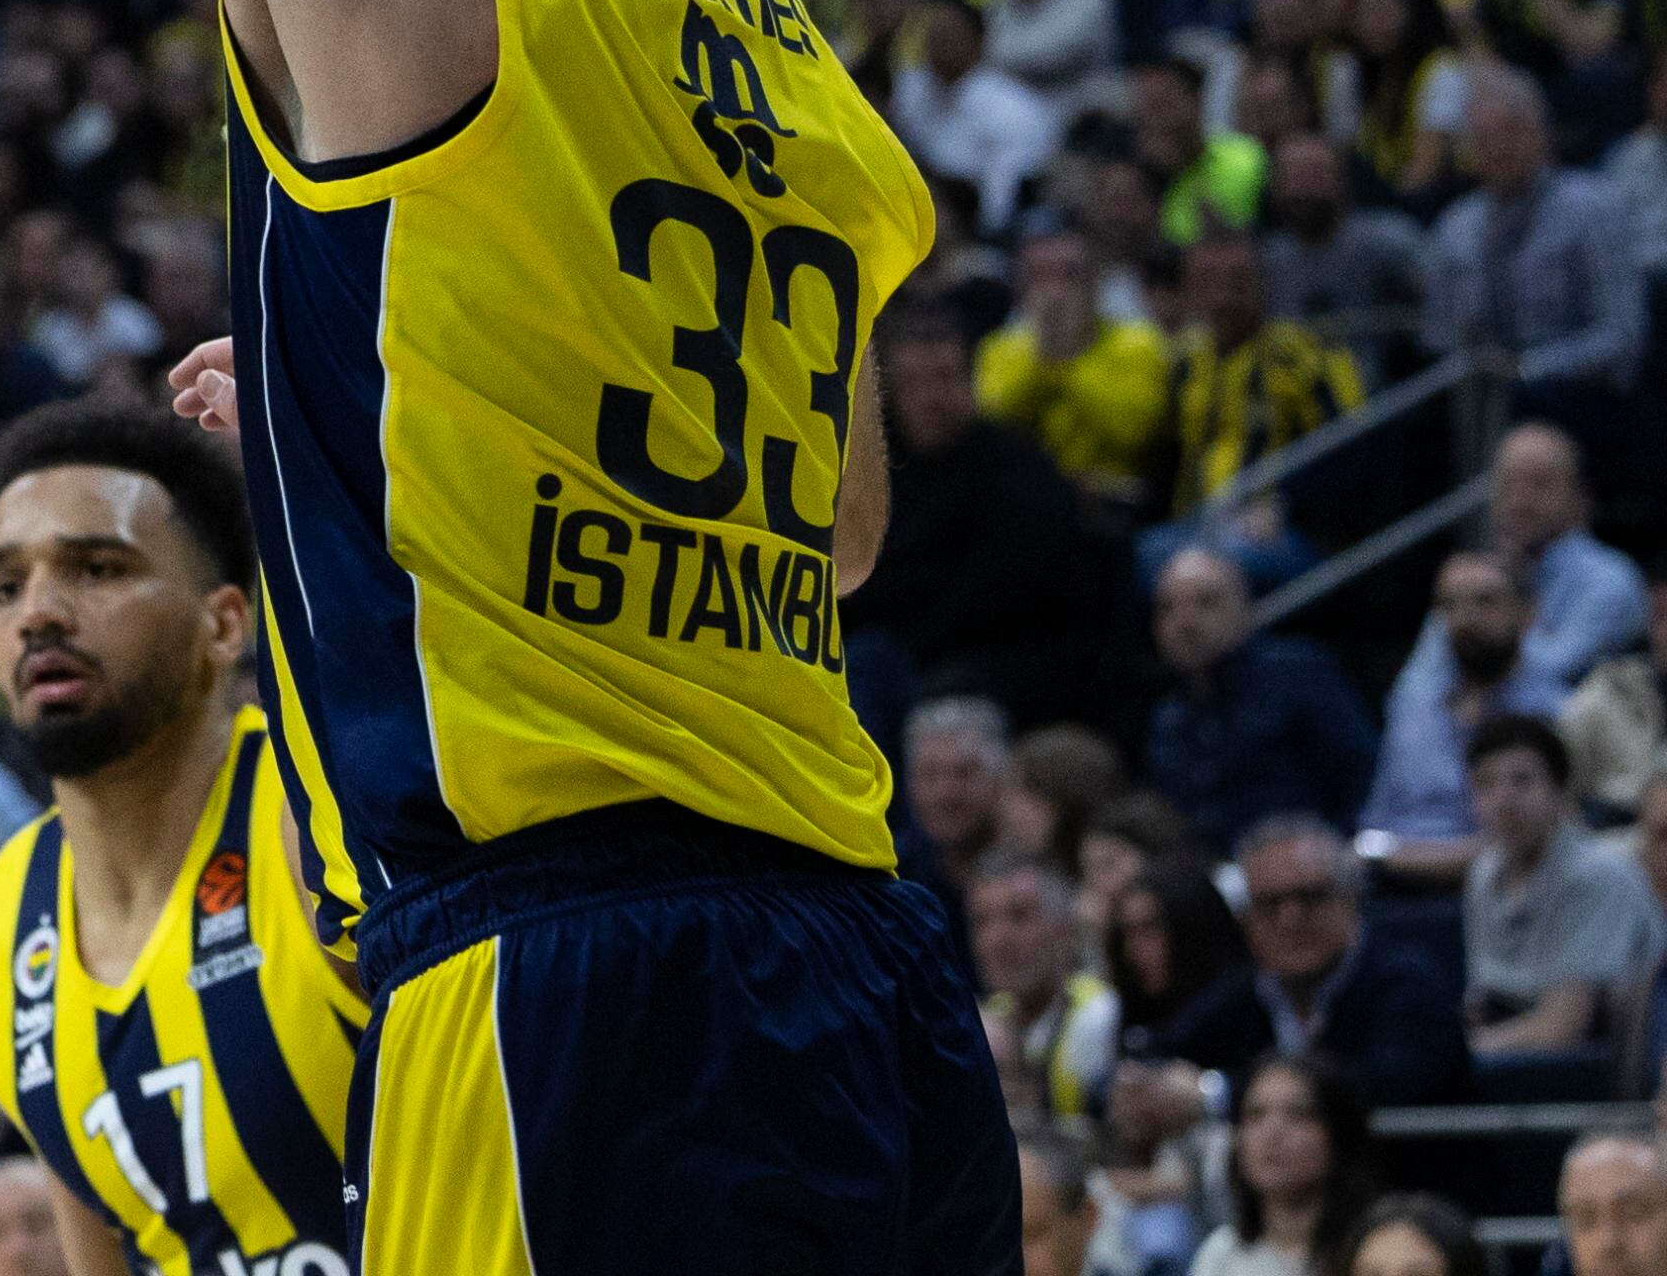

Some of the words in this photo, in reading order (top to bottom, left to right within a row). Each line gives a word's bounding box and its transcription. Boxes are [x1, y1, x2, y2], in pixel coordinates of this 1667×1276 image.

[595, 177, 860, 559] 33
[523, 473, 844, 674] İSTANBU
[82, 1056, 210, 1213] 17
